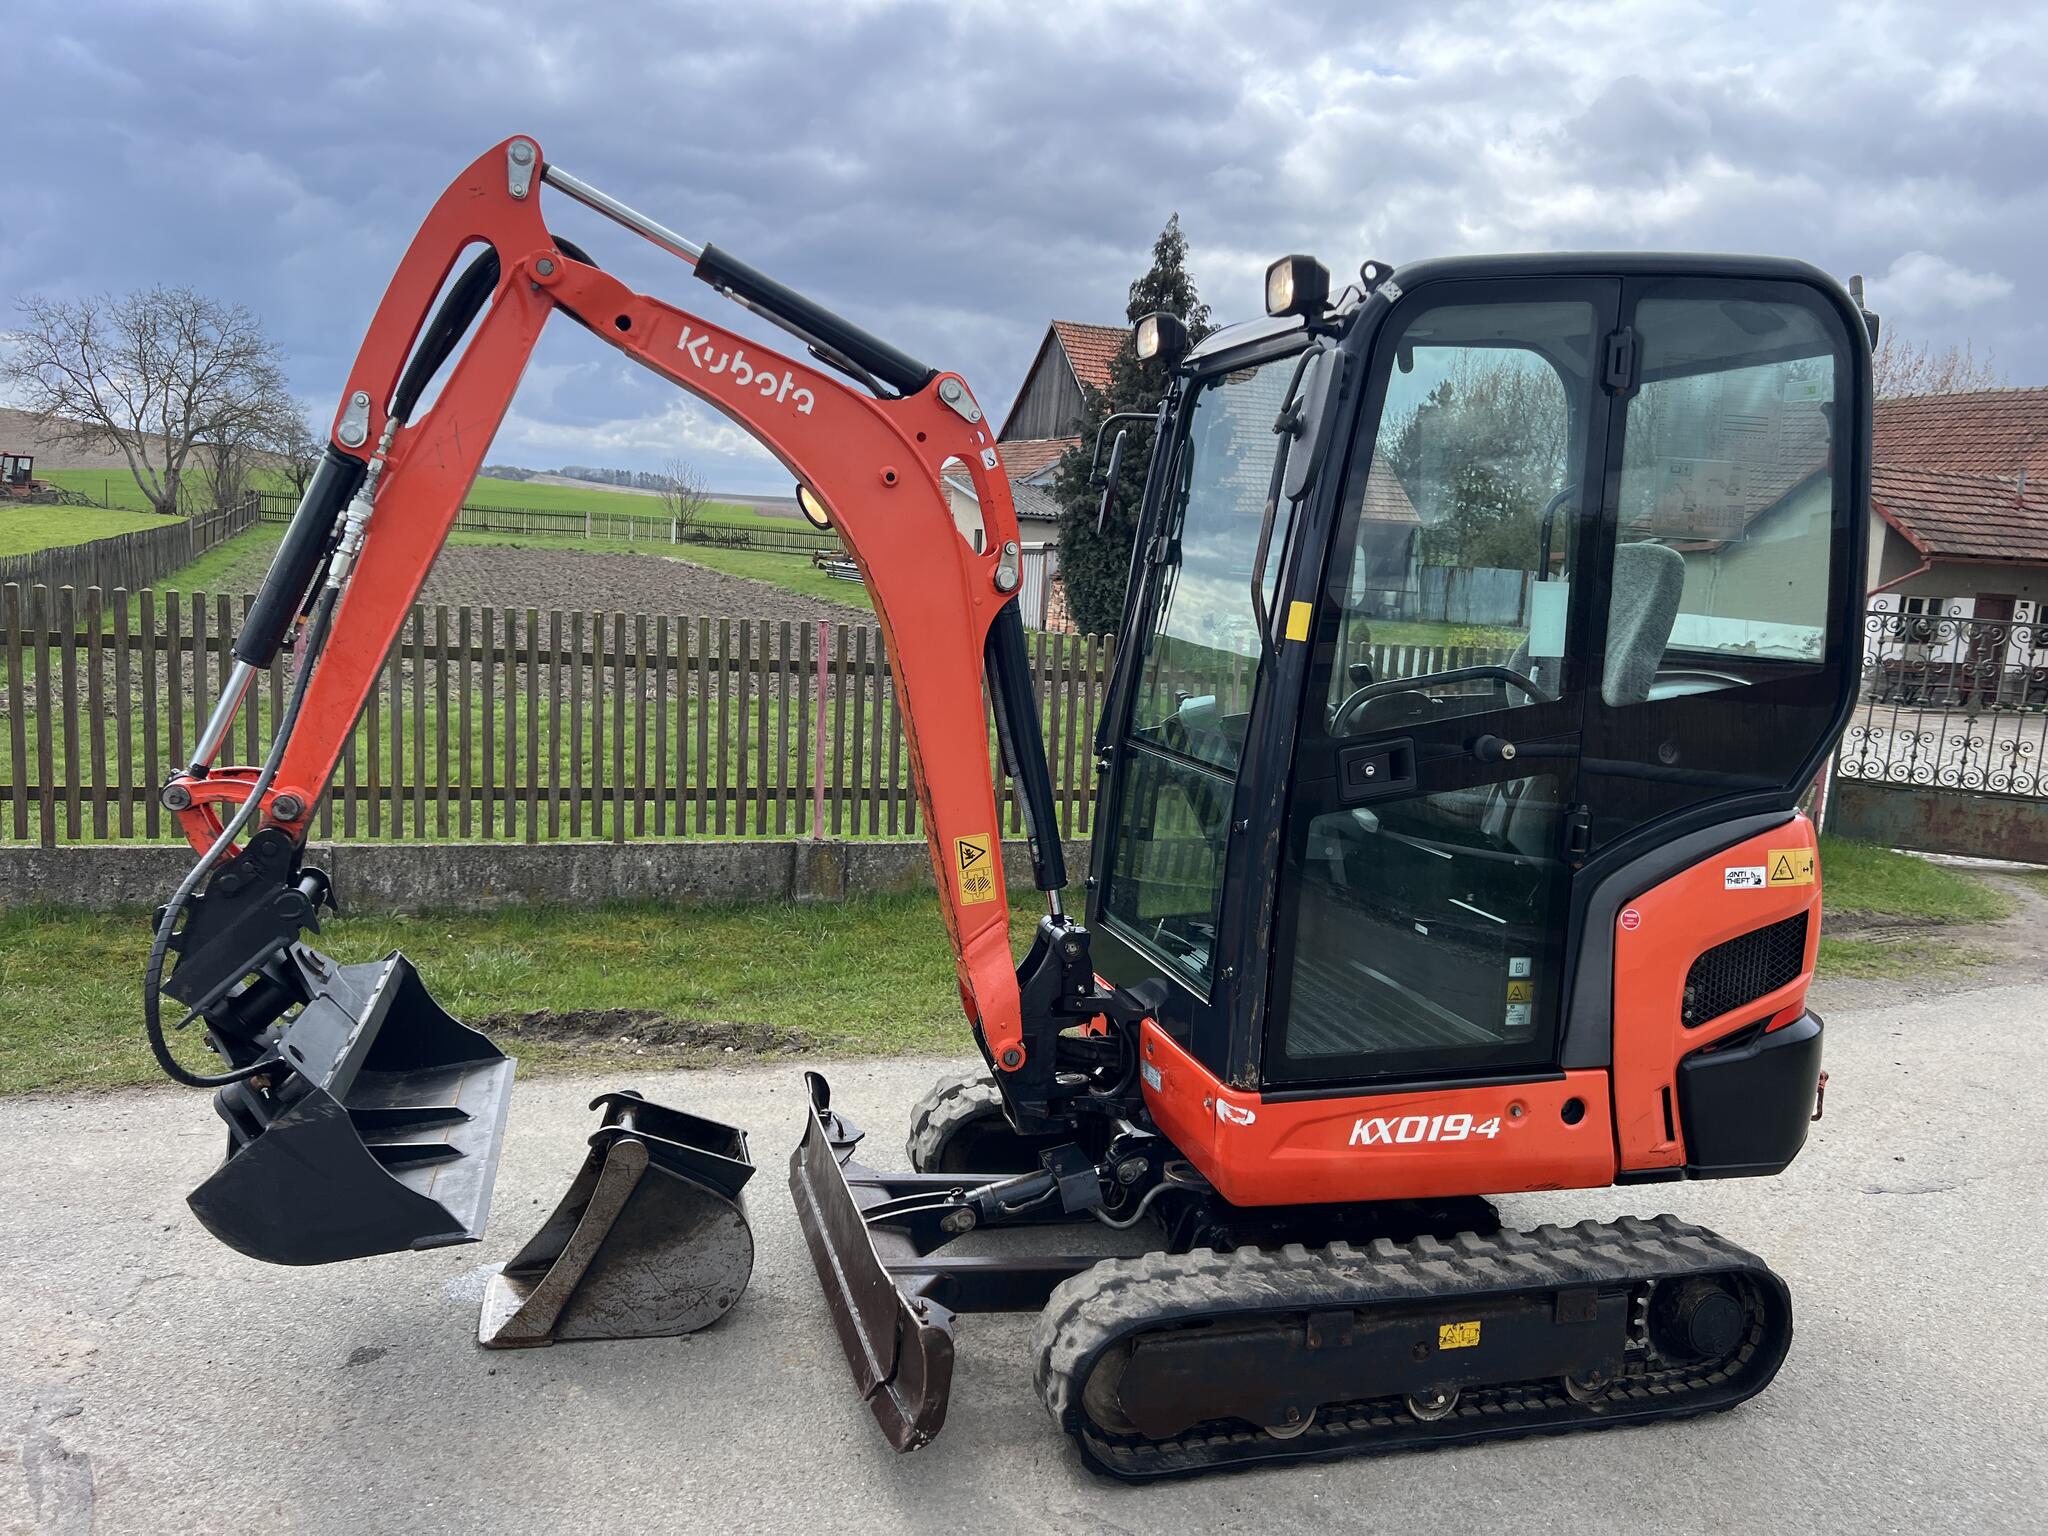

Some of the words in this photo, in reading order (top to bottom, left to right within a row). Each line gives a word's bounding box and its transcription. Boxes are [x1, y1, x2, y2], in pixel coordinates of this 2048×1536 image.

[677, 325, 816, 416] Kubota
[1726, 877, 1750, 885] THEFT
[1348, 1113, 1501, 1146] KX019-4
